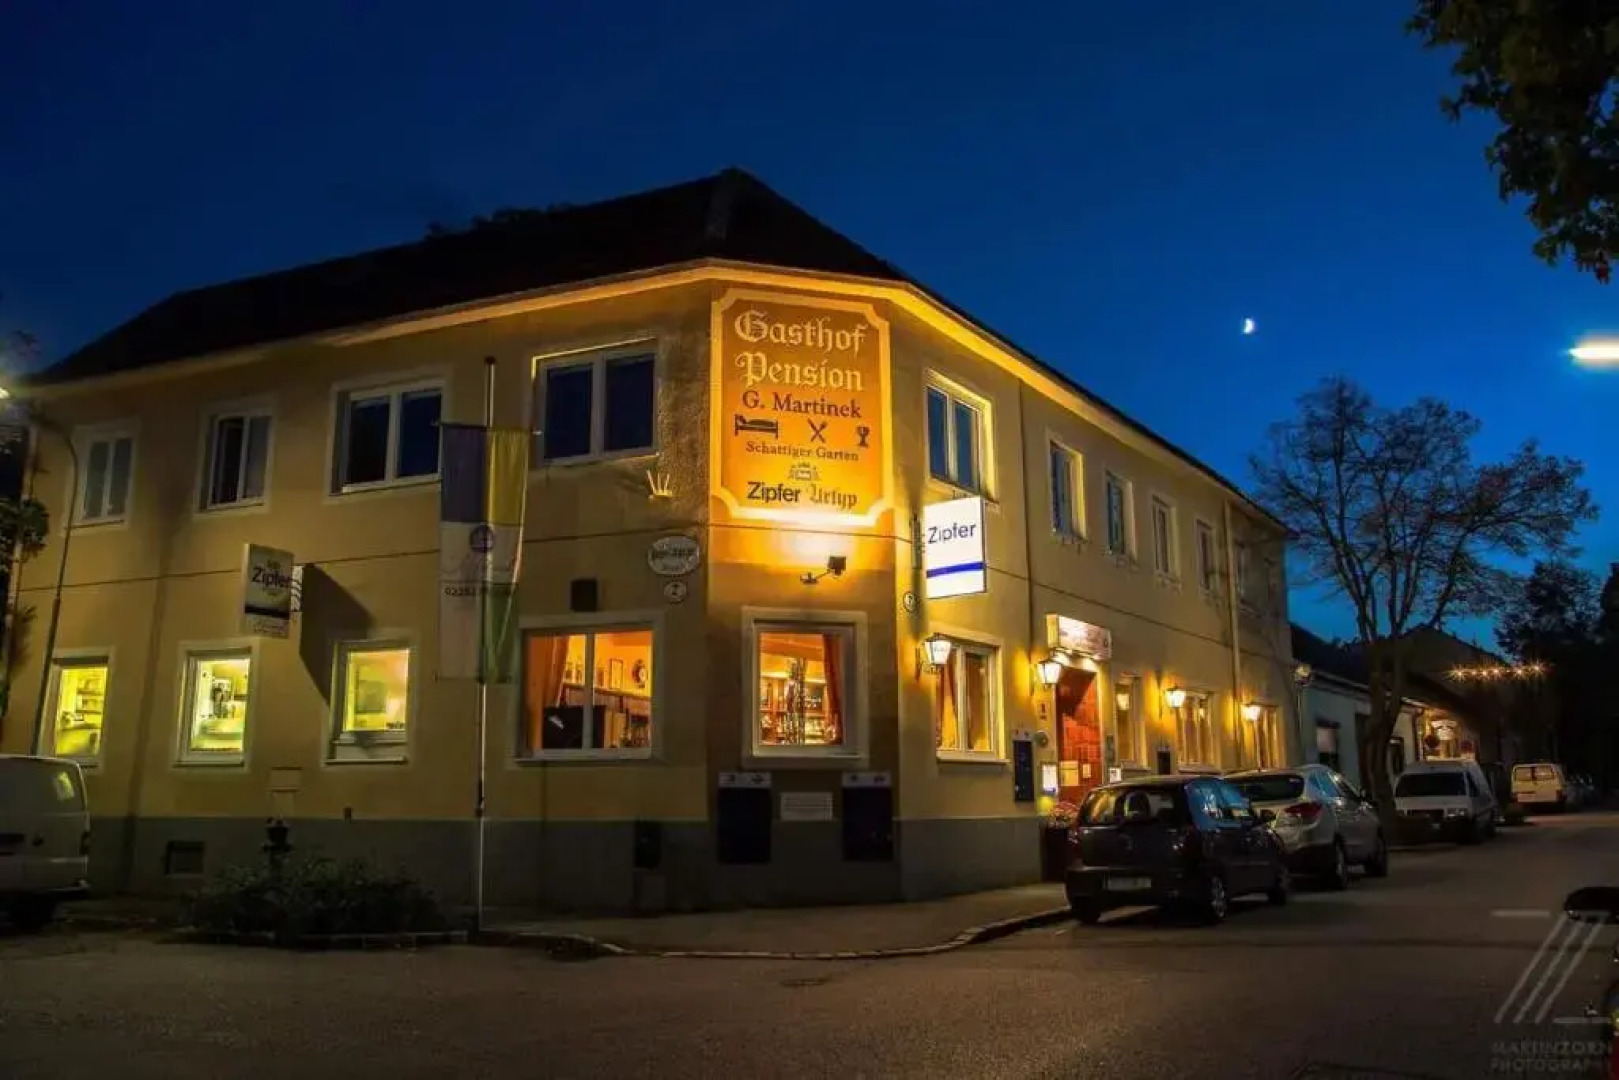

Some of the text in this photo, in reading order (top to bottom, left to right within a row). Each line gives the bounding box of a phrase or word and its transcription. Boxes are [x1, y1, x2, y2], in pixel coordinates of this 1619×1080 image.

[734, 309, 869, 359] Gasthof
[735, 351, 863, 392] Pension
[742, 390, 862, 418] G. Martinek
[745, 440, 859, 461] Schattiger Garten
[747, 481, 801, 503] Zipfer
[927, 522, 976, 544] Zipfer
